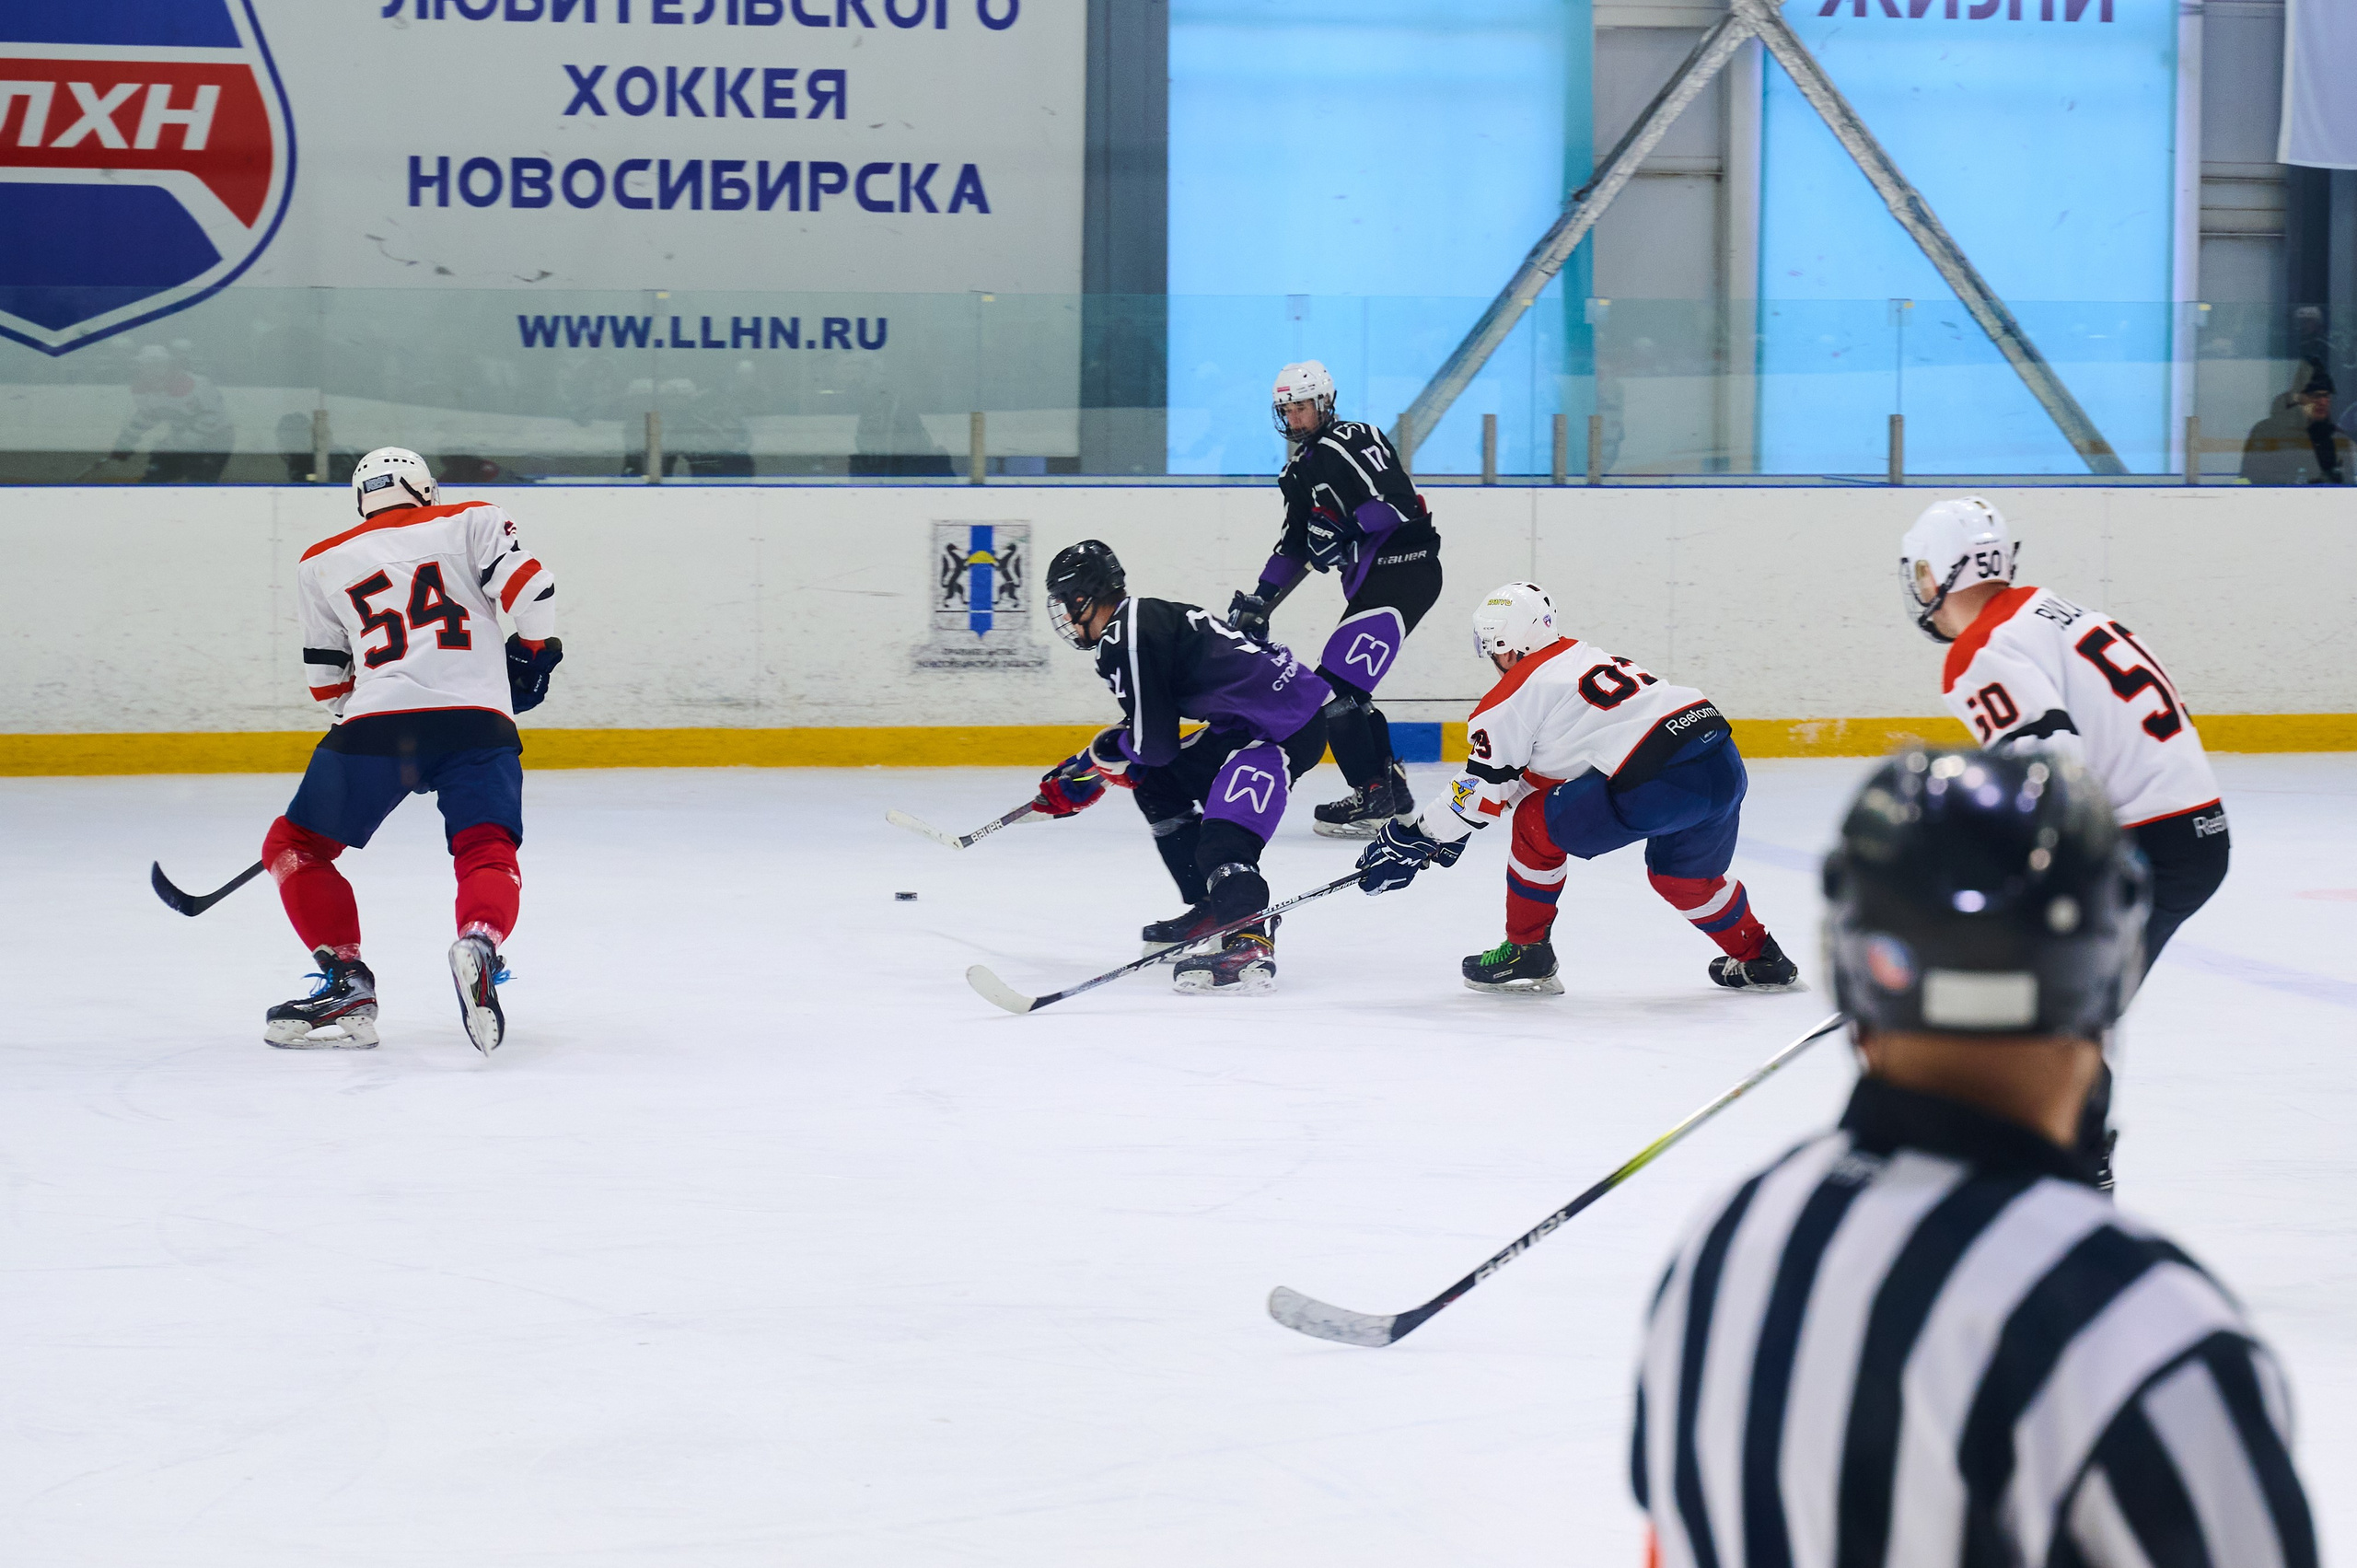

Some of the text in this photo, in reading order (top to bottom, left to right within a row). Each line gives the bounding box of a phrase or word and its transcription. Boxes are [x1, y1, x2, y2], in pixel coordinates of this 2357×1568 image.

[563, 64, 848, 120] ХОККЕЯ
[407, 155, 992, 215] НОВОСИБИРСКА
[517, 314, 888, 351] WWW.LLHN.RU
[1975, 550, 2002, 579] 50
[344, 561, 472, 670] 54
[2075, 620, 2195, 743] 5
